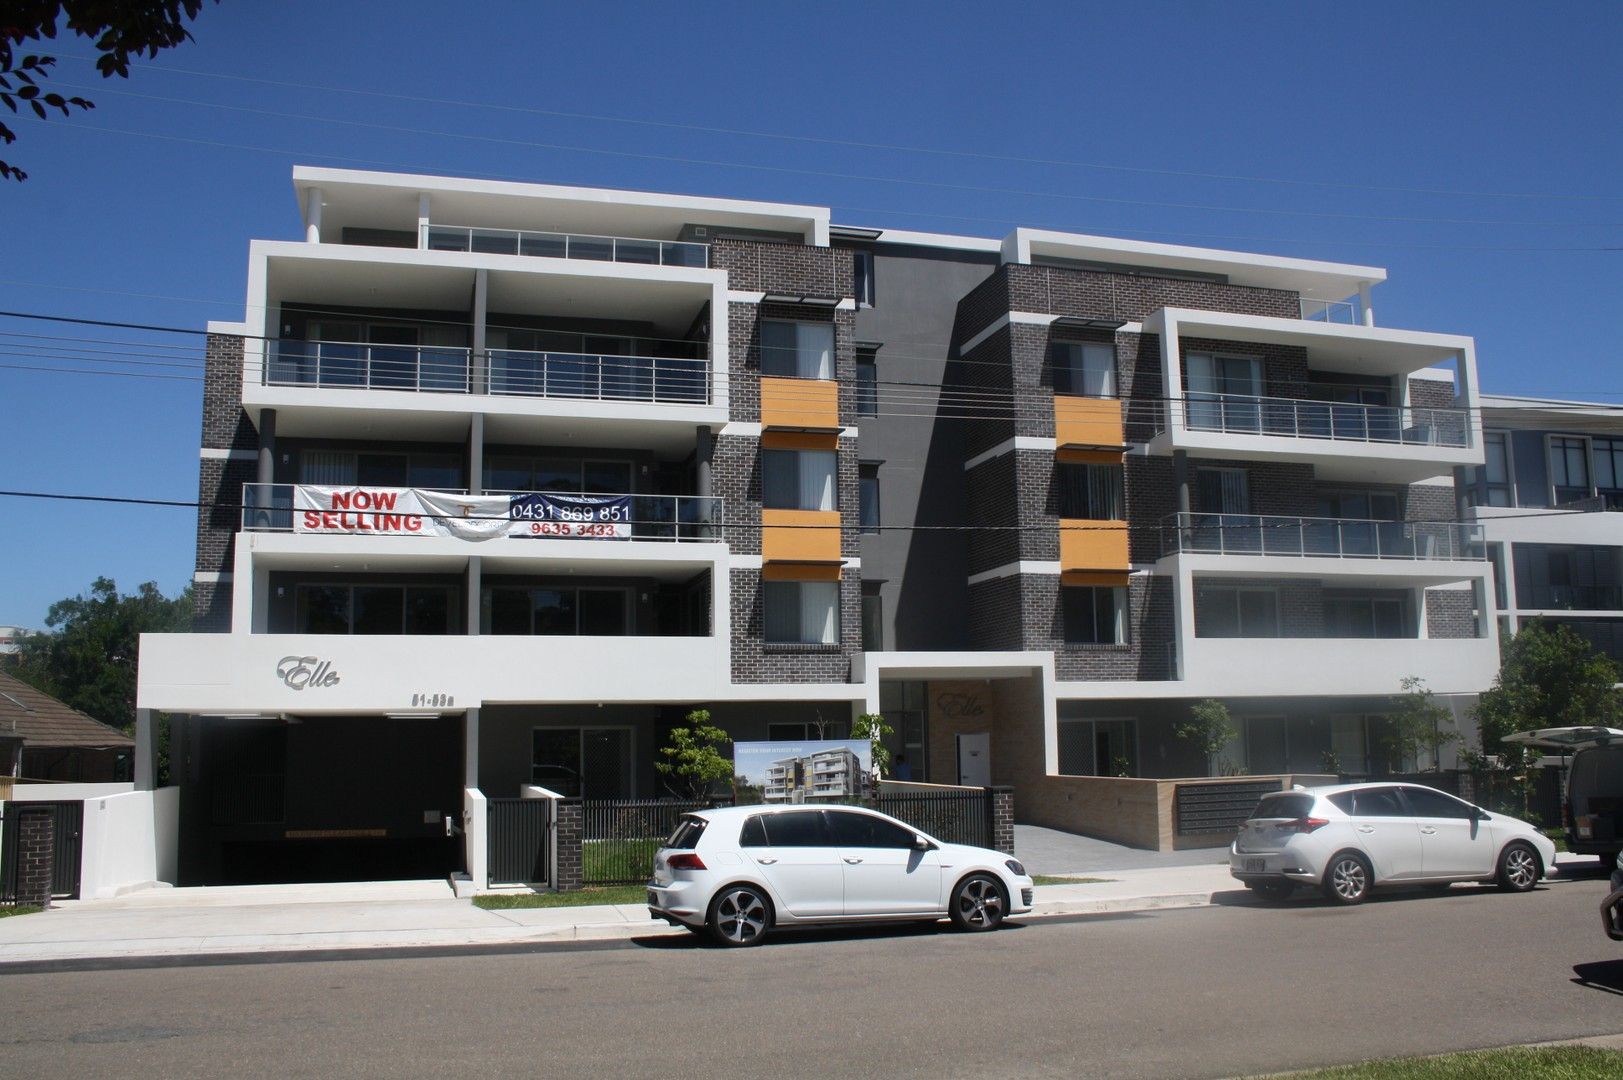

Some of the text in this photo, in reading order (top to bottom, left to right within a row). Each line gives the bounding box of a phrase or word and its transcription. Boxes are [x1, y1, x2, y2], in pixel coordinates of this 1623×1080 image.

[332, 491, 398, 511] NOW
[303, 510, 422, 532] SELLING
[512, 503, 630, 521] 0431 869 851
[531, 522, 615, 536] 9635 3433
[276, 655, 341, 691] Elle
